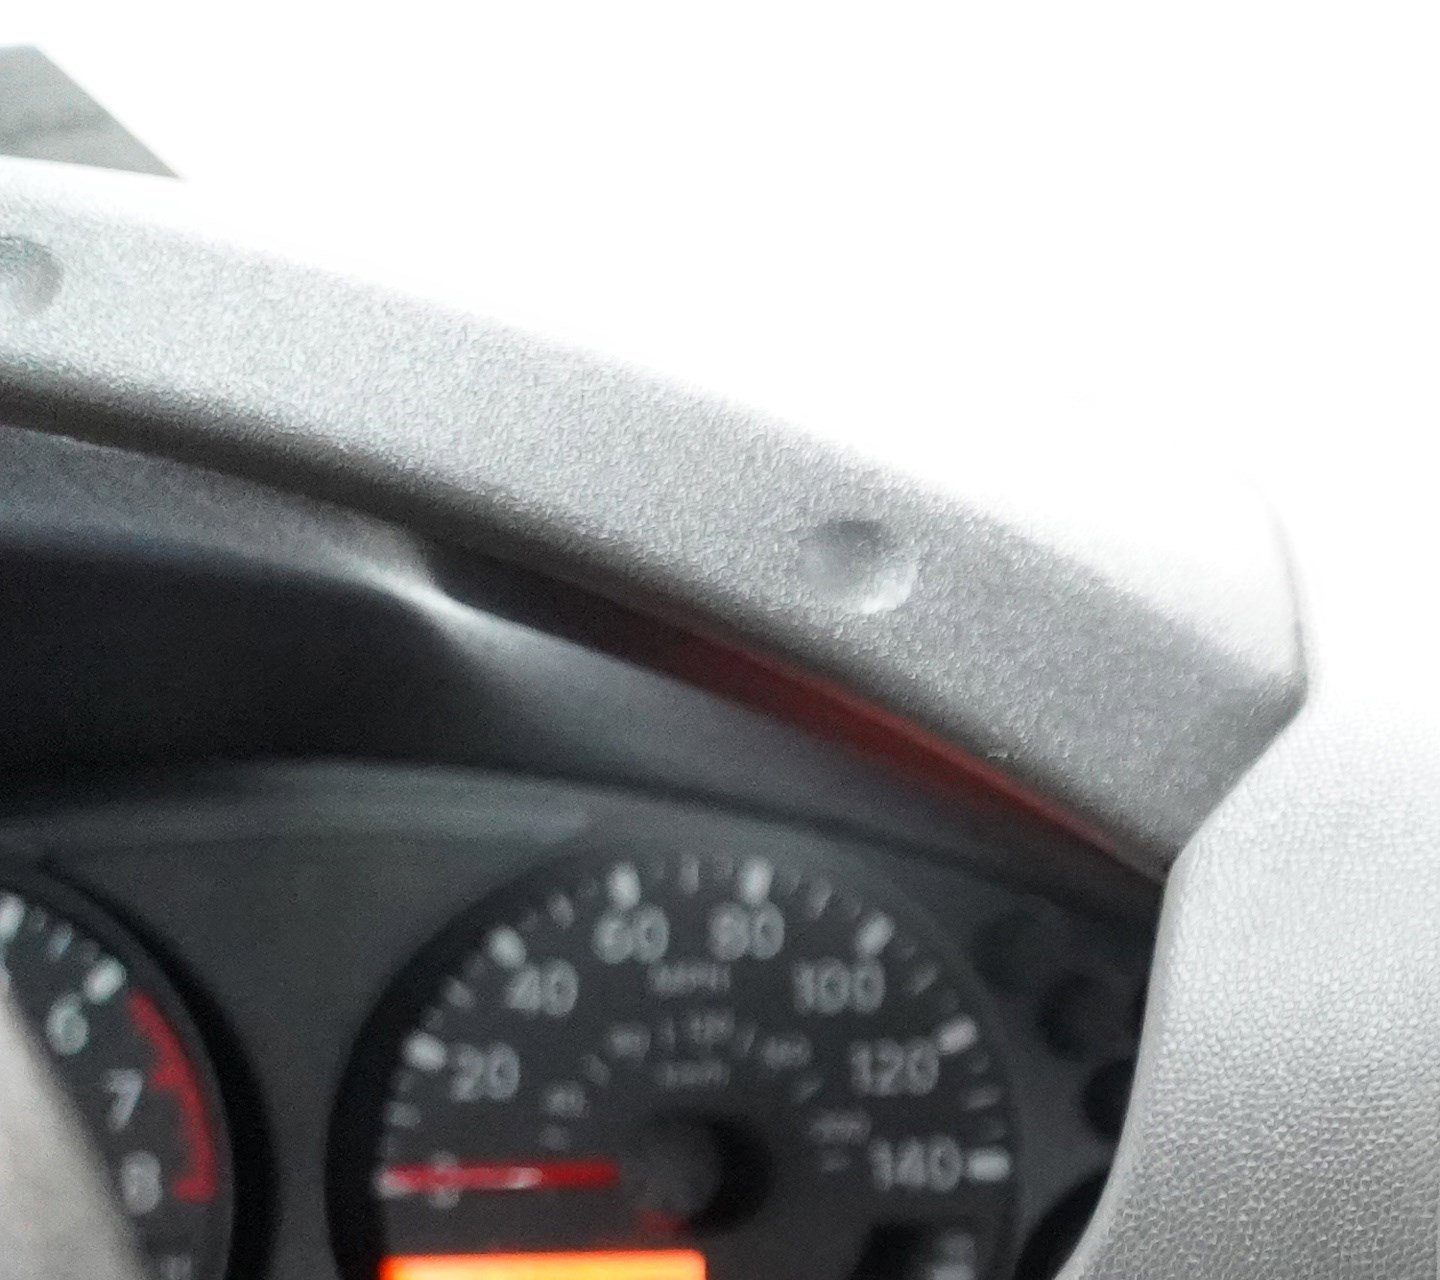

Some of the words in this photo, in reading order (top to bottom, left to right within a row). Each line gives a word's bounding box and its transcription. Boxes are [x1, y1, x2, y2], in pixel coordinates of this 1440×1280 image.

[594, 902, 669, 964] 60
[710, 902, 785, 960] 80
[504, 959, 578, 1017] 40
[795, 956, 886, 1015] 100
[45, 992, 90, 1055] 6
[448, 1041, 520, 1101] 20
[849, 1039, 939, 1096] 120
[102, 1066, 144, 1133] 7
[869, 1135, 963, 1191] 140
